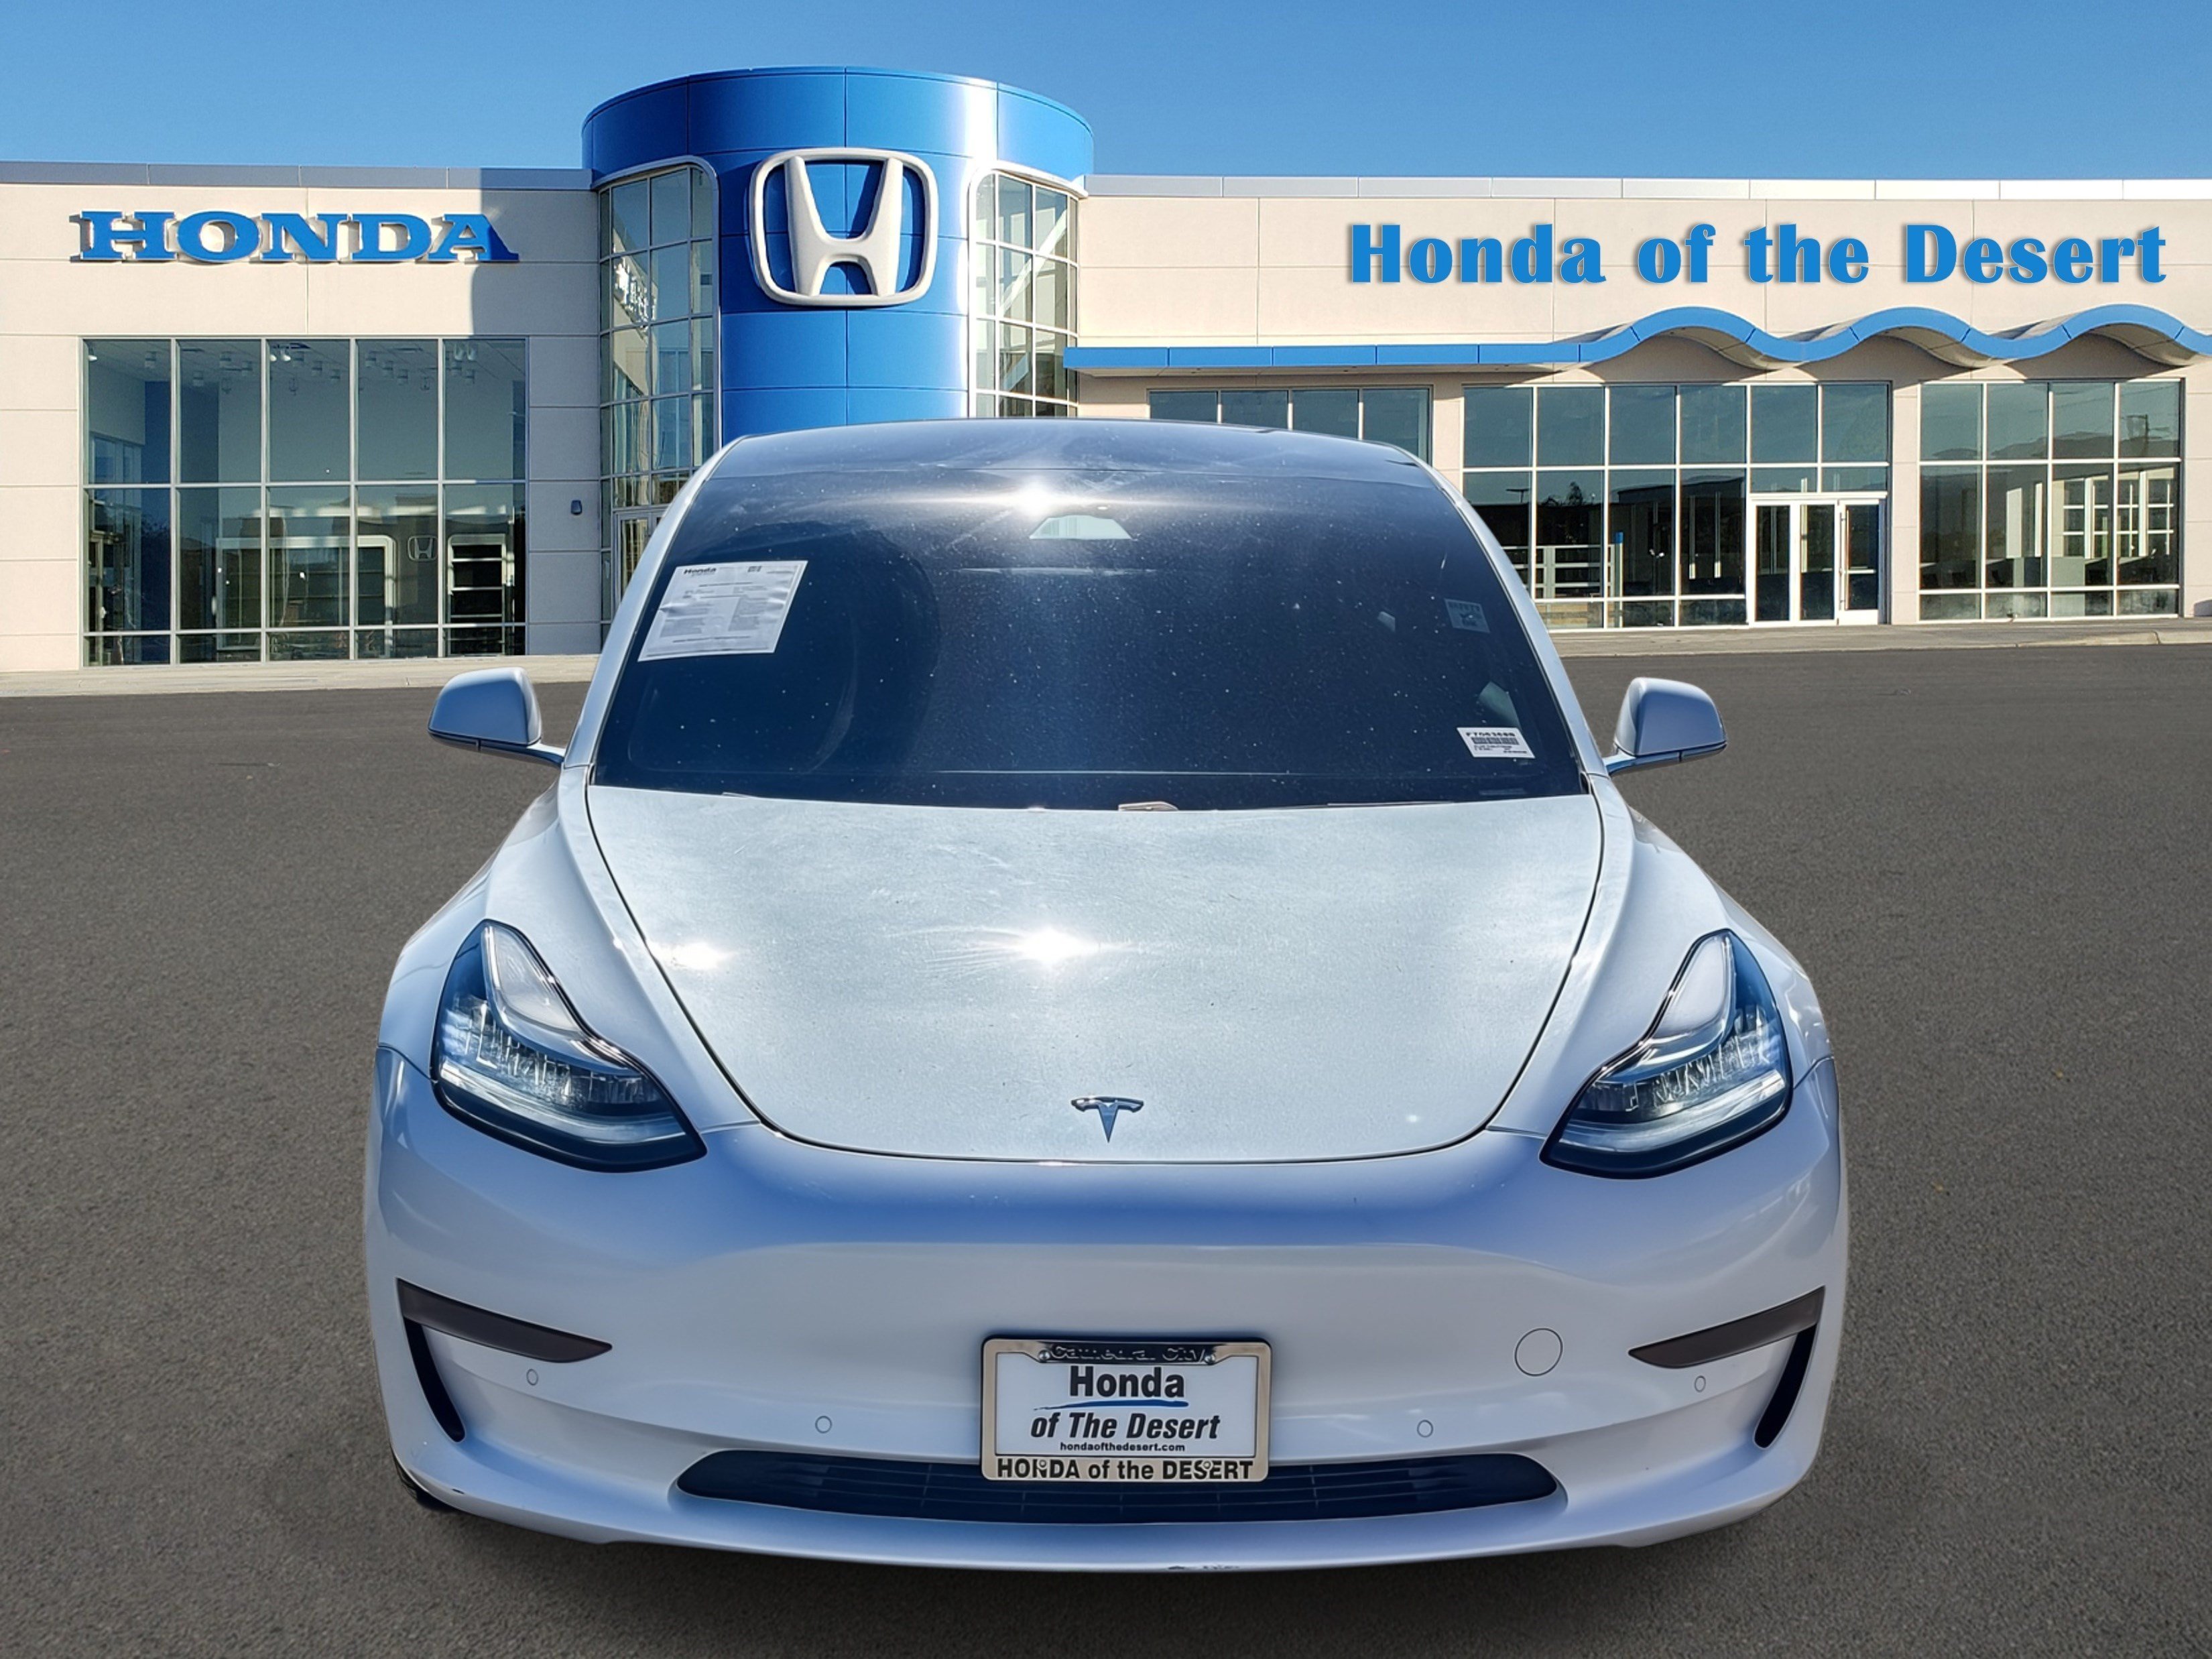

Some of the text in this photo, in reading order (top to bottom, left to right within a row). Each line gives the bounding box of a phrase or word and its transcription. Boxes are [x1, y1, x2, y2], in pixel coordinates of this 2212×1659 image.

[78, 210, 520, 263] HONDA
[1351, 223, 2167, 284] Honda of the Desert
[1070, 1365, 1185, 1398] Honda
[1030, 1412, 1221, 1439] of The Desert
[1060, 1441, 1185, 1452] hondaofthedesert.com
[997, 1458, 1253, 1480] HONDA of the DESERT
